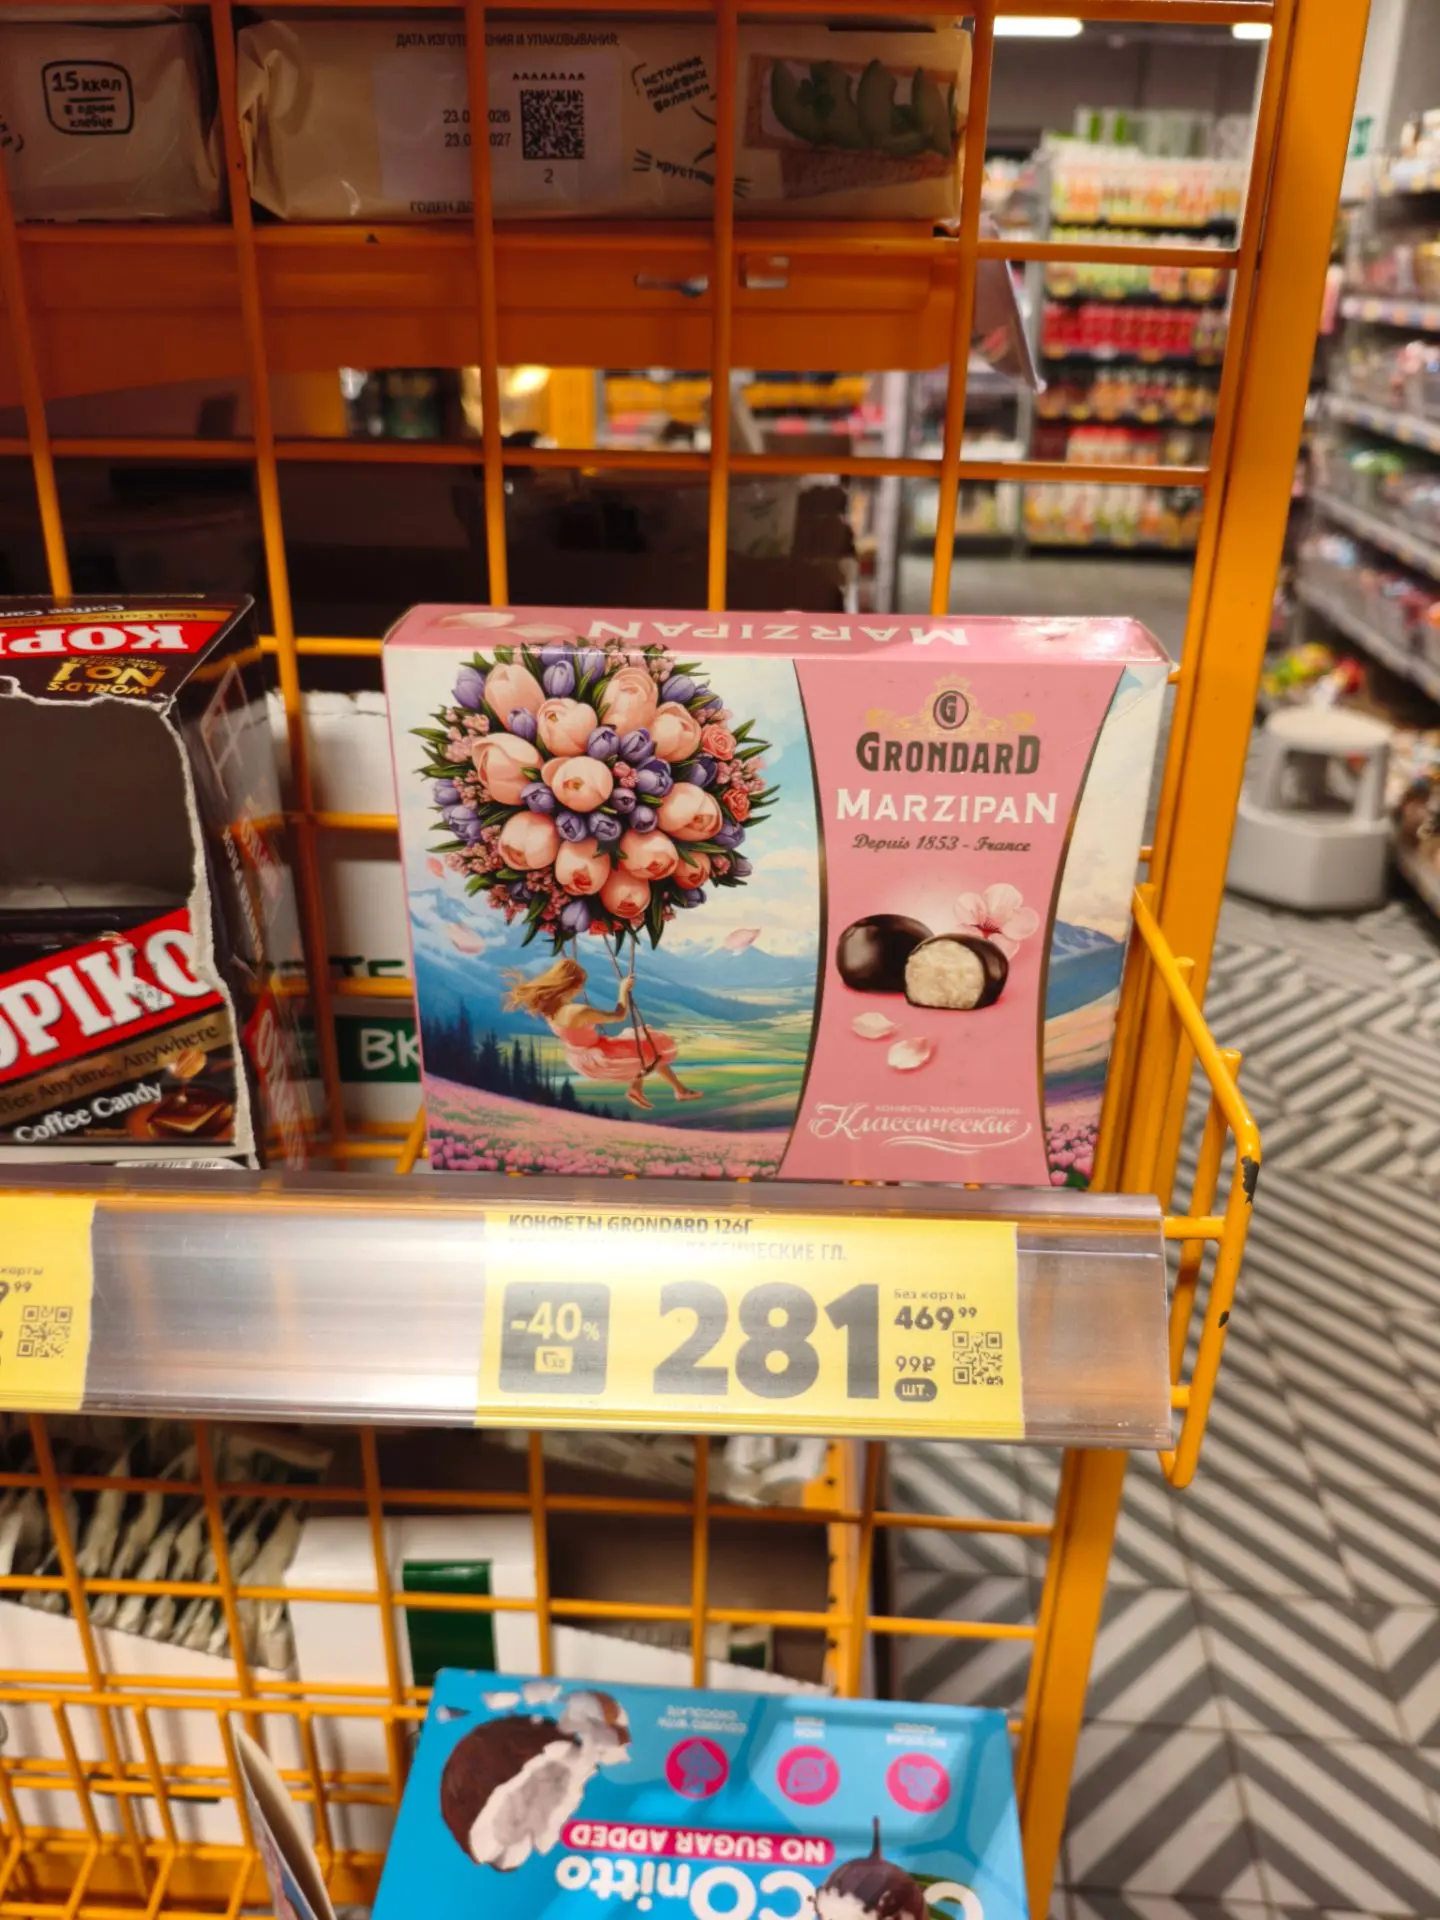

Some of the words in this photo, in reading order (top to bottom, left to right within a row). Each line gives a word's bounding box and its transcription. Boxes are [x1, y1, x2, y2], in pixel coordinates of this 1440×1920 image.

[52, 71, 78, 93] 15
[81, 76, 122, 94] ккал
[543, 169, 554, 184] 2
[588, 619, 970, 647] MARZIPAN
[47, 680, 148, 695] WORLD'S
[856, 731, 1041, 775] GRONDARD
[836, 788, 1058, 824] MARZIPAN
[852, 833, 910, 852] Depuis
[916, 835, 960, 850] 1853
[973, 836, 1031, 852] France
[123, 1024, 220, 1071] Anywhere
[13, 1109, 92, 1143] Coffee
[91, 1081, 162, 1119] Candy
[808, 1101, 1019, 1139] Классические
[508, 1214, 602, 1233] КОНФЕТЫ
[607, 1216, 708, 1234] GRONDARD
[920, 1291, 966, 1302] карты
[511, 1301, 600, 1342] -40%
[894, 1305, 954, 1331] 469
[653, 1280, 880, 1400] 281
[569, 1824, 669, 1852] ADDED
[675, 1831, 774, 1860] SUGAR
[780, 1838, 826, 1863] NO
